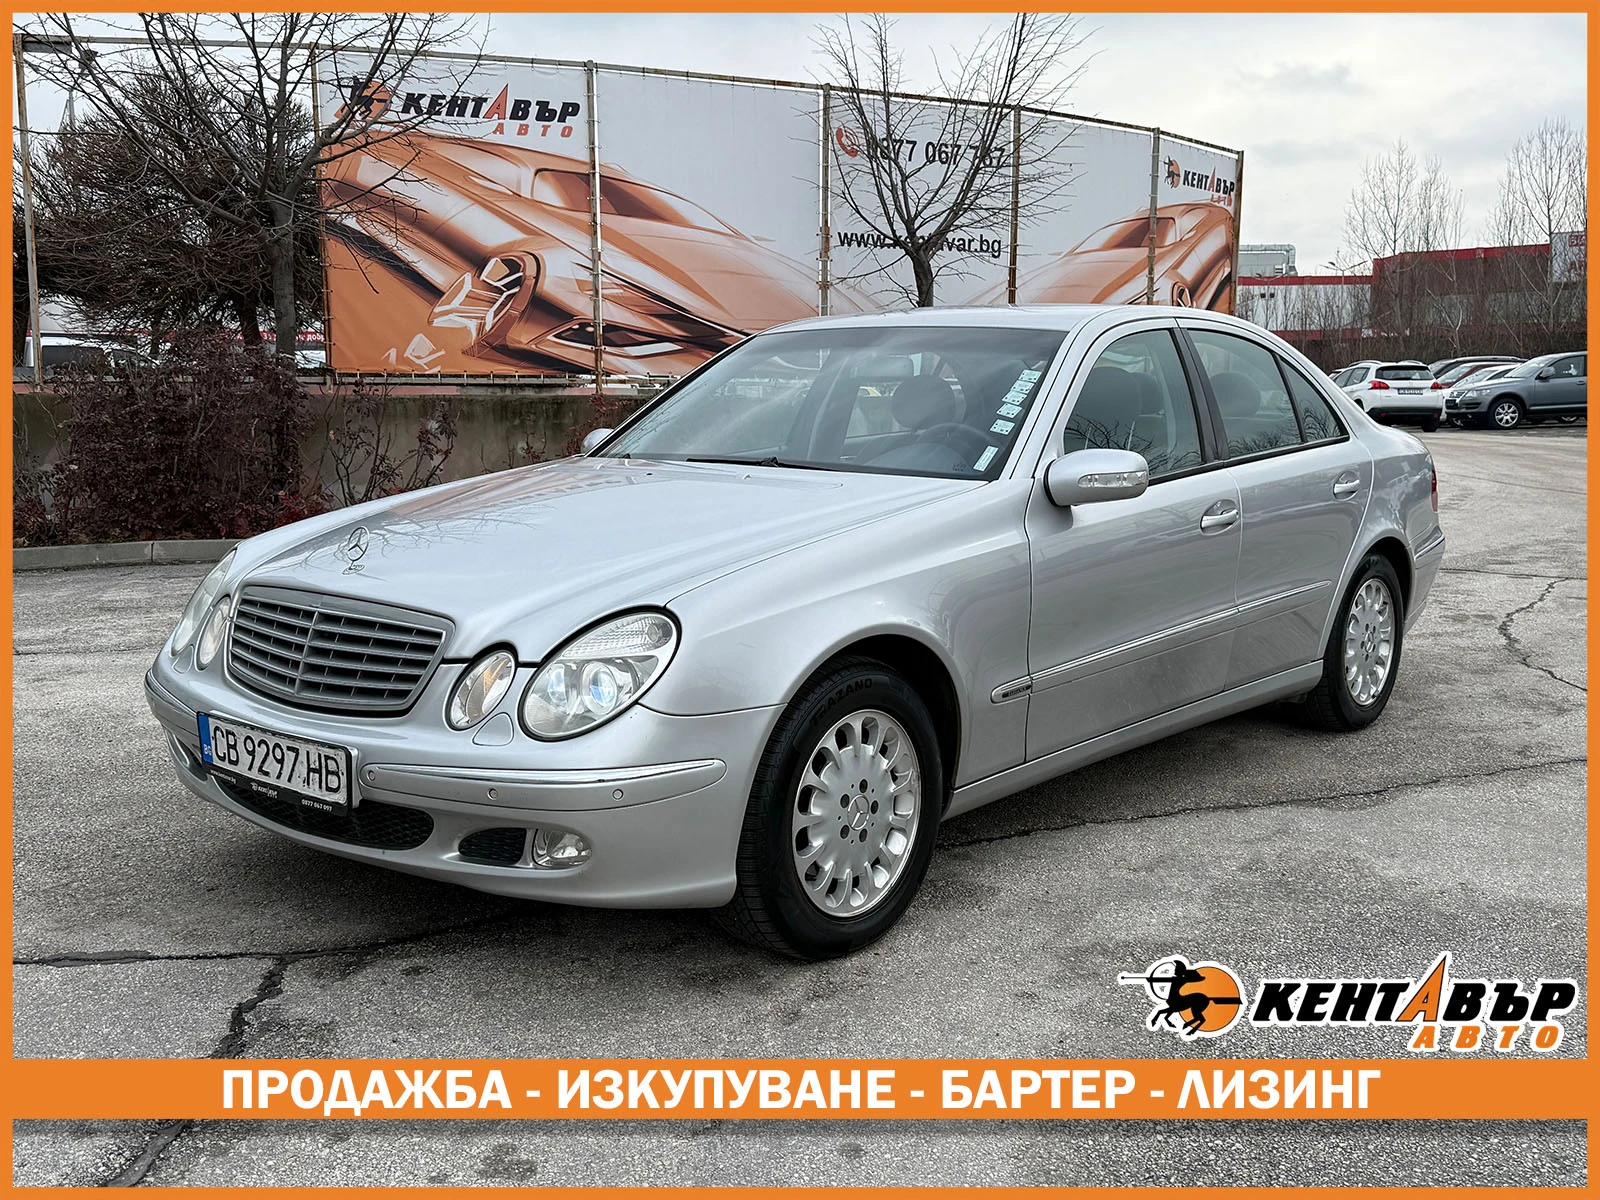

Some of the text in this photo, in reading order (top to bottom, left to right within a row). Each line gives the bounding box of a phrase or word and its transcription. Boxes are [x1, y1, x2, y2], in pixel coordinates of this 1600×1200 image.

[401, 83, 581, 123] КЕНТАВЪР
[493, 123, 574, 138] АВТО
[866, 138, 918, 162] 877
[924, 141, 962, 165] 067
[1182, 166, 1235, 196] КЕНТАВЪР
[837, 231, 1002, 258] www.var.bg
[213, 726, 342, 793] CB 9297 HB
